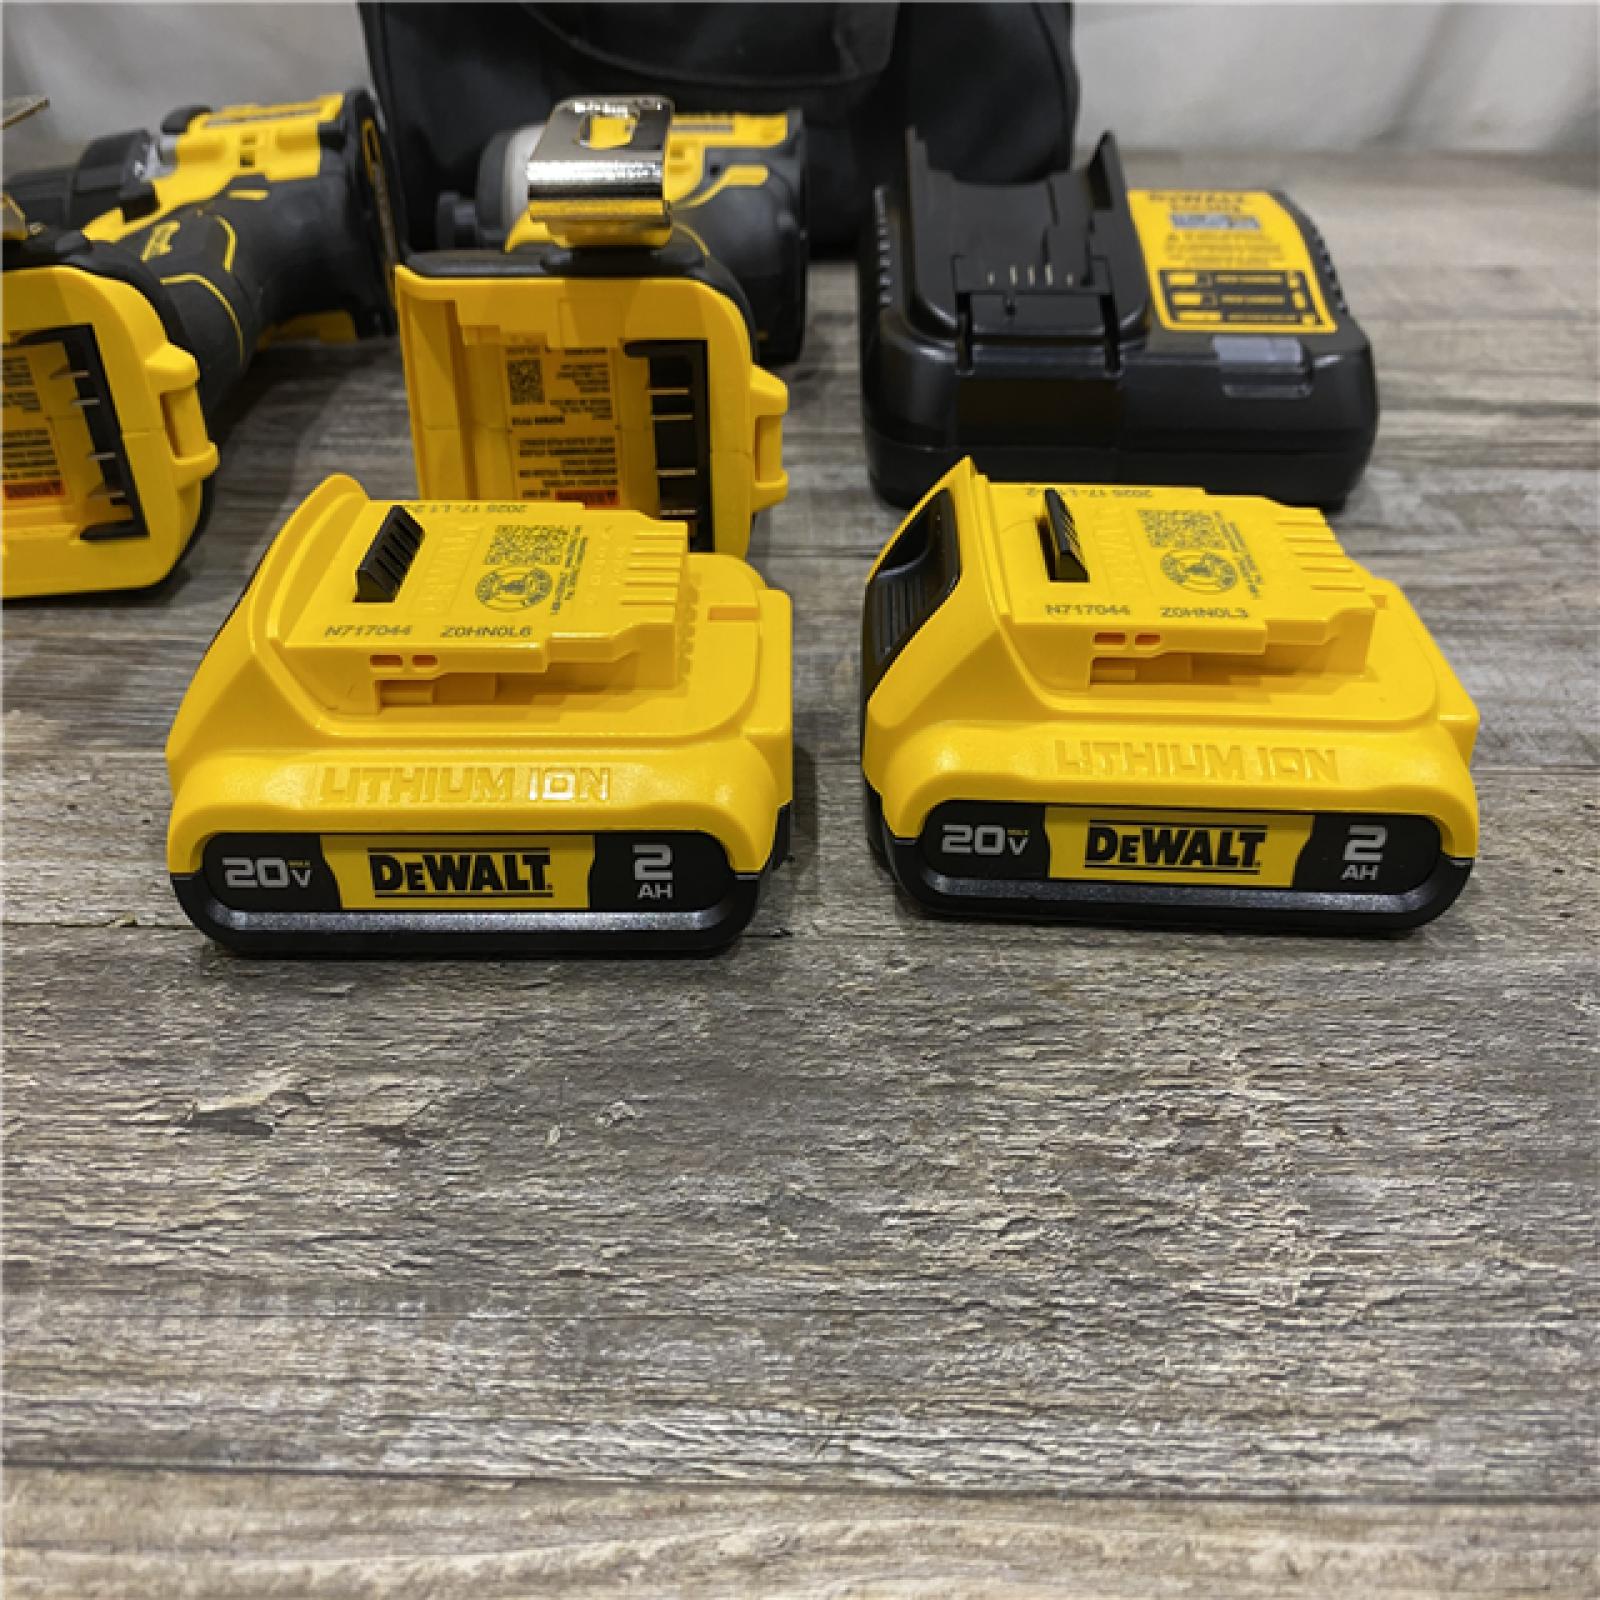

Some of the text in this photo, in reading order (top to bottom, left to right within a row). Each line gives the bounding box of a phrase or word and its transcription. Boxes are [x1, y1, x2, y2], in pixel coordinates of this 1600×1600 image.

[1054, 740, 1340, 782] LITHIUM ION
[319, 767, 611, 801] LITHIUM ION
[1343, 825, 1388, 862] 2
[632, 844, 674, 881] 2
[1340, 864, 1378, 880] AH
[637, 883, 673, 899] AH
